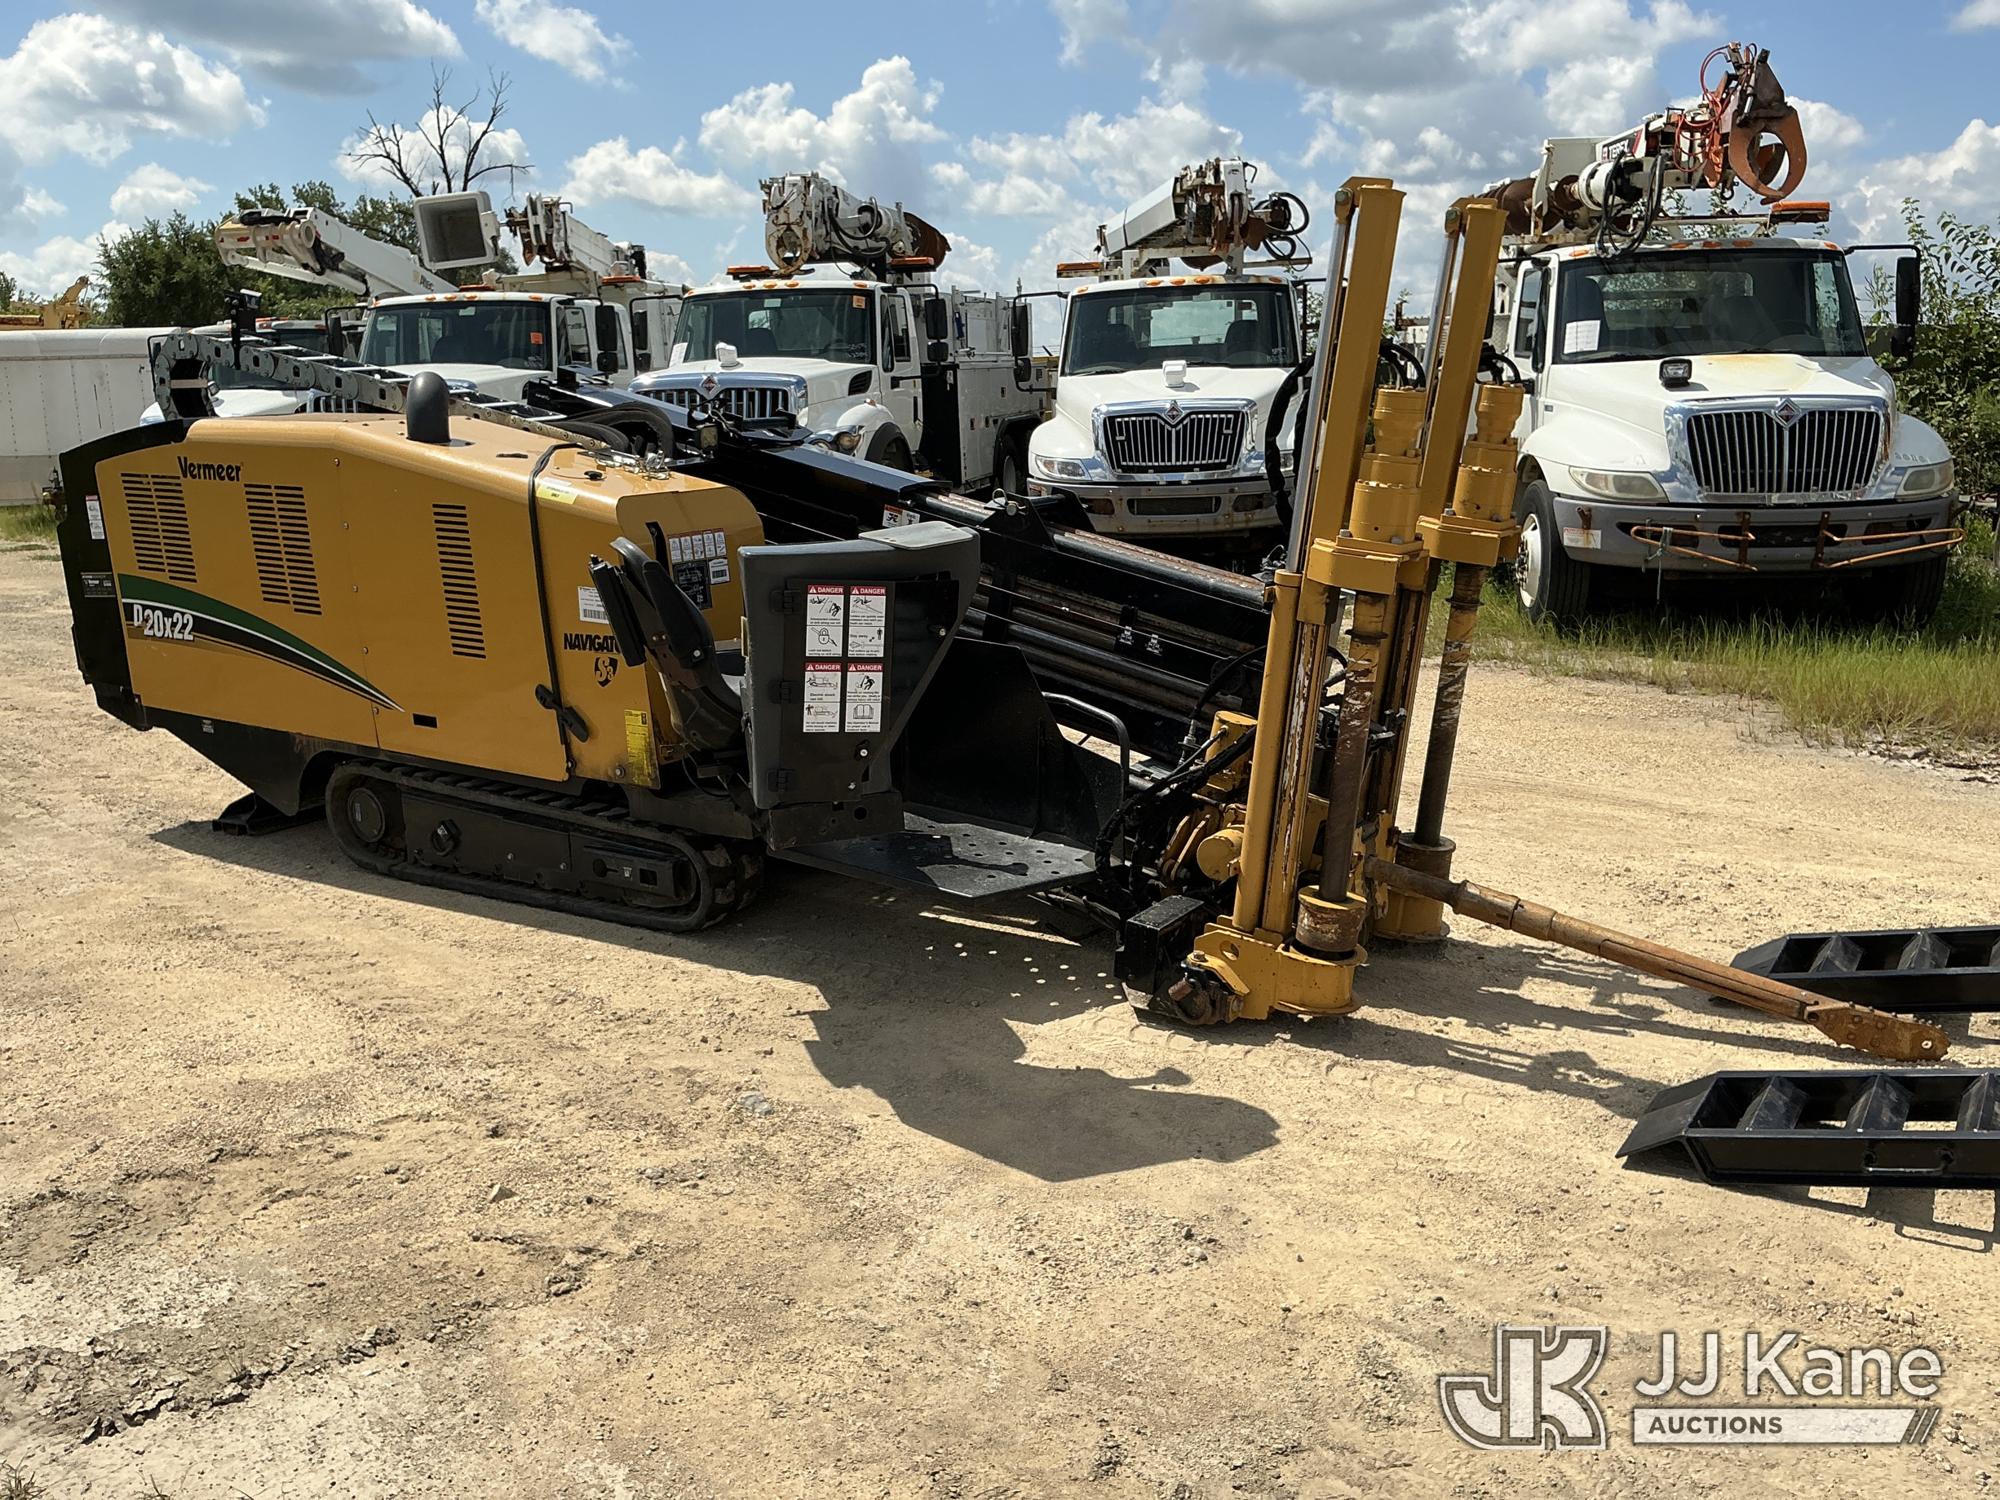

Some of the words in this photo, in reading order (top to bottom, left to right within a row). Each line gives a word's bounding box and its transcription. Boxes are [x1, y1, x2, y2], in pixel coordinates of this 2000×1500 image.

[177, 456, 241, 481] Vermeer
[817, 586, 844, 594] DANGER
[133, 603, 194, 641] D20x22
[564, 633, 620, 654] NAVIGAT
[815, 663, 841, 671] DANGER
